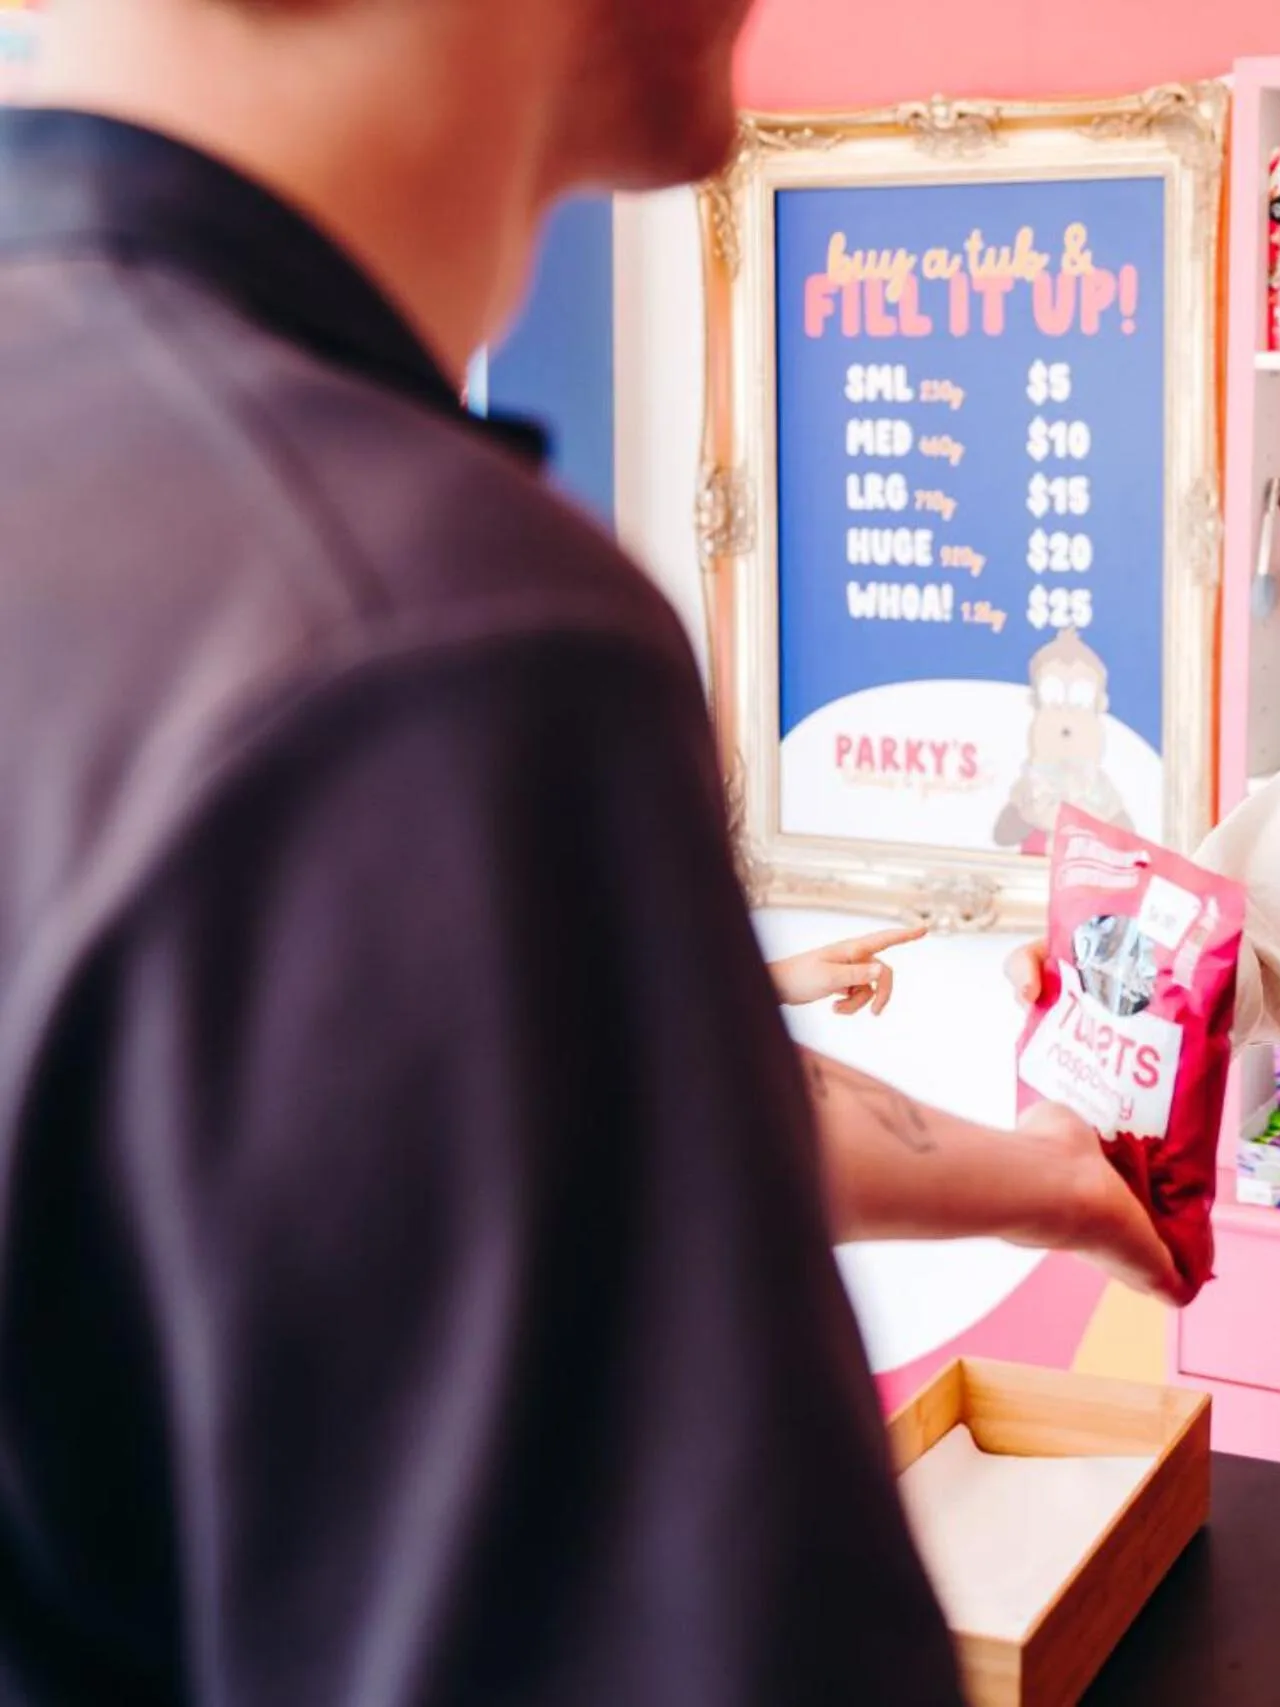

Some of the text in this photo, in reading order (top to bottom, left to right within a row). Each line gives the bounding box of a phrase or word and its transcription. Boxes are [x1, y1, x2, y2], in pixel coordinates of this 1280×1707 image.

[827, 221, 1094, 302] buy a tub &
[804, 264, 1139, 338] FILL IT UP!
[845, 364, 913, 402] SML
[1026, 359, 1071, 405] $5
[846, 418, 912, 457] MED
[1026, 416, 1091, 462] $10
[846, 472, 908, 511] LRG
[1026, 472, 1090, 518] $15
[846, 527, 933, 567] HUGE
[1026, 528, 1092, 574] $20
[847, 581, 954, 622] WHOA!
[1026, 584, 1093, 629] $25
[834, 733, 979, 779] PARKY'S
